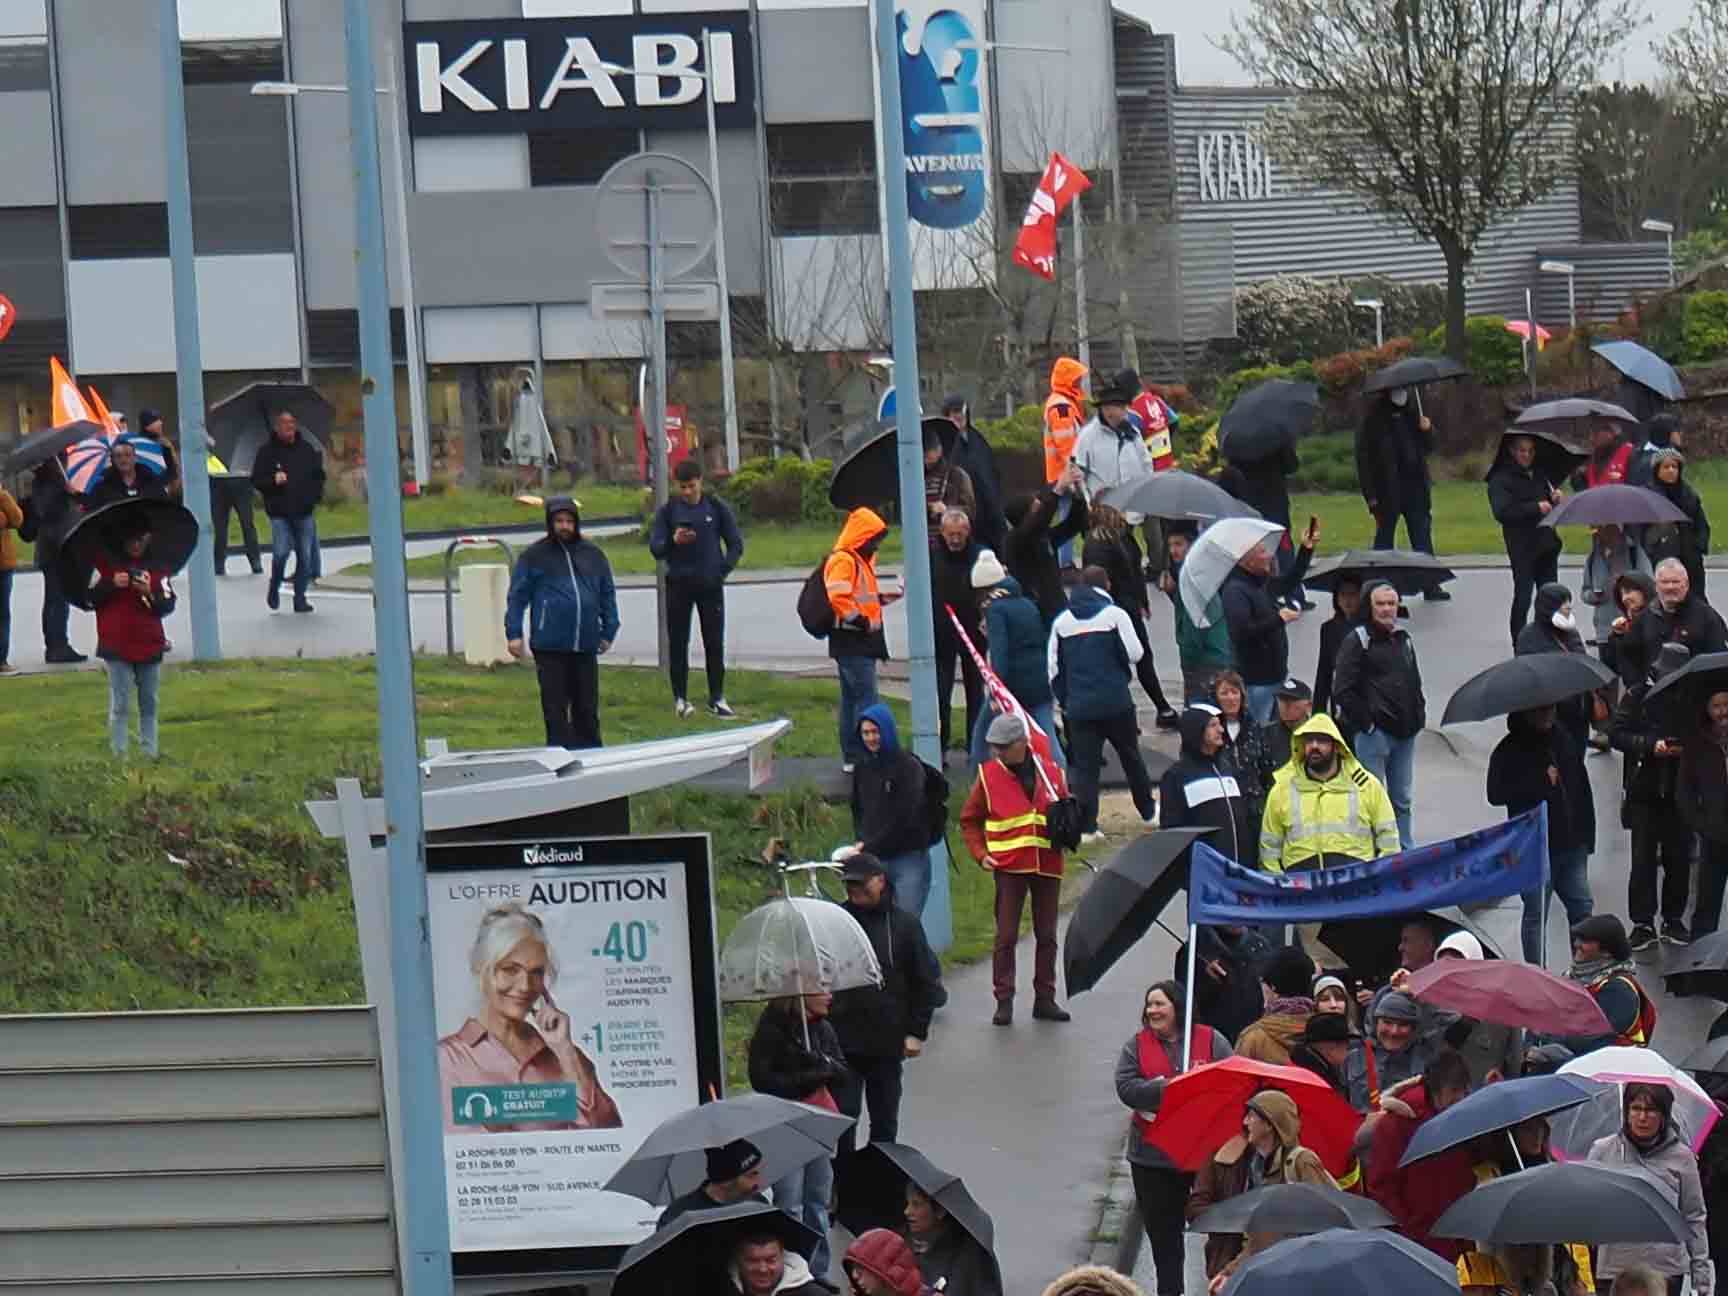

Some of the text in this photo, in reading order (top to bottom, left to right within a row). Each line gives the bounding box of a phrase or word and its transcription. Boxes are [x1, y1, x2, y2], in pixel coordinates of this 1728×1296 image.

[416, 31, 737, 113] KIABI
[449, 878, 667, 905] L'OFFRE AUDITION
[624, 976, 673, 985] MARQUES
[607, 1031, 666, 1042] LUNETTES
[502, 1088, 566, 1100] TEST AUDITIF
[502, 1099, 548, 1112] GRATUIT
[455, 1149, 467, 1160] LA
[468, 1147, 539, 1159] ROCHE-SUR-YON
[588, 1143, 622, 1154] NANTES
[457, 1185, 468, 1196] LA
[470, 1183, 541, 1195] ROCHE-SUR-YON
